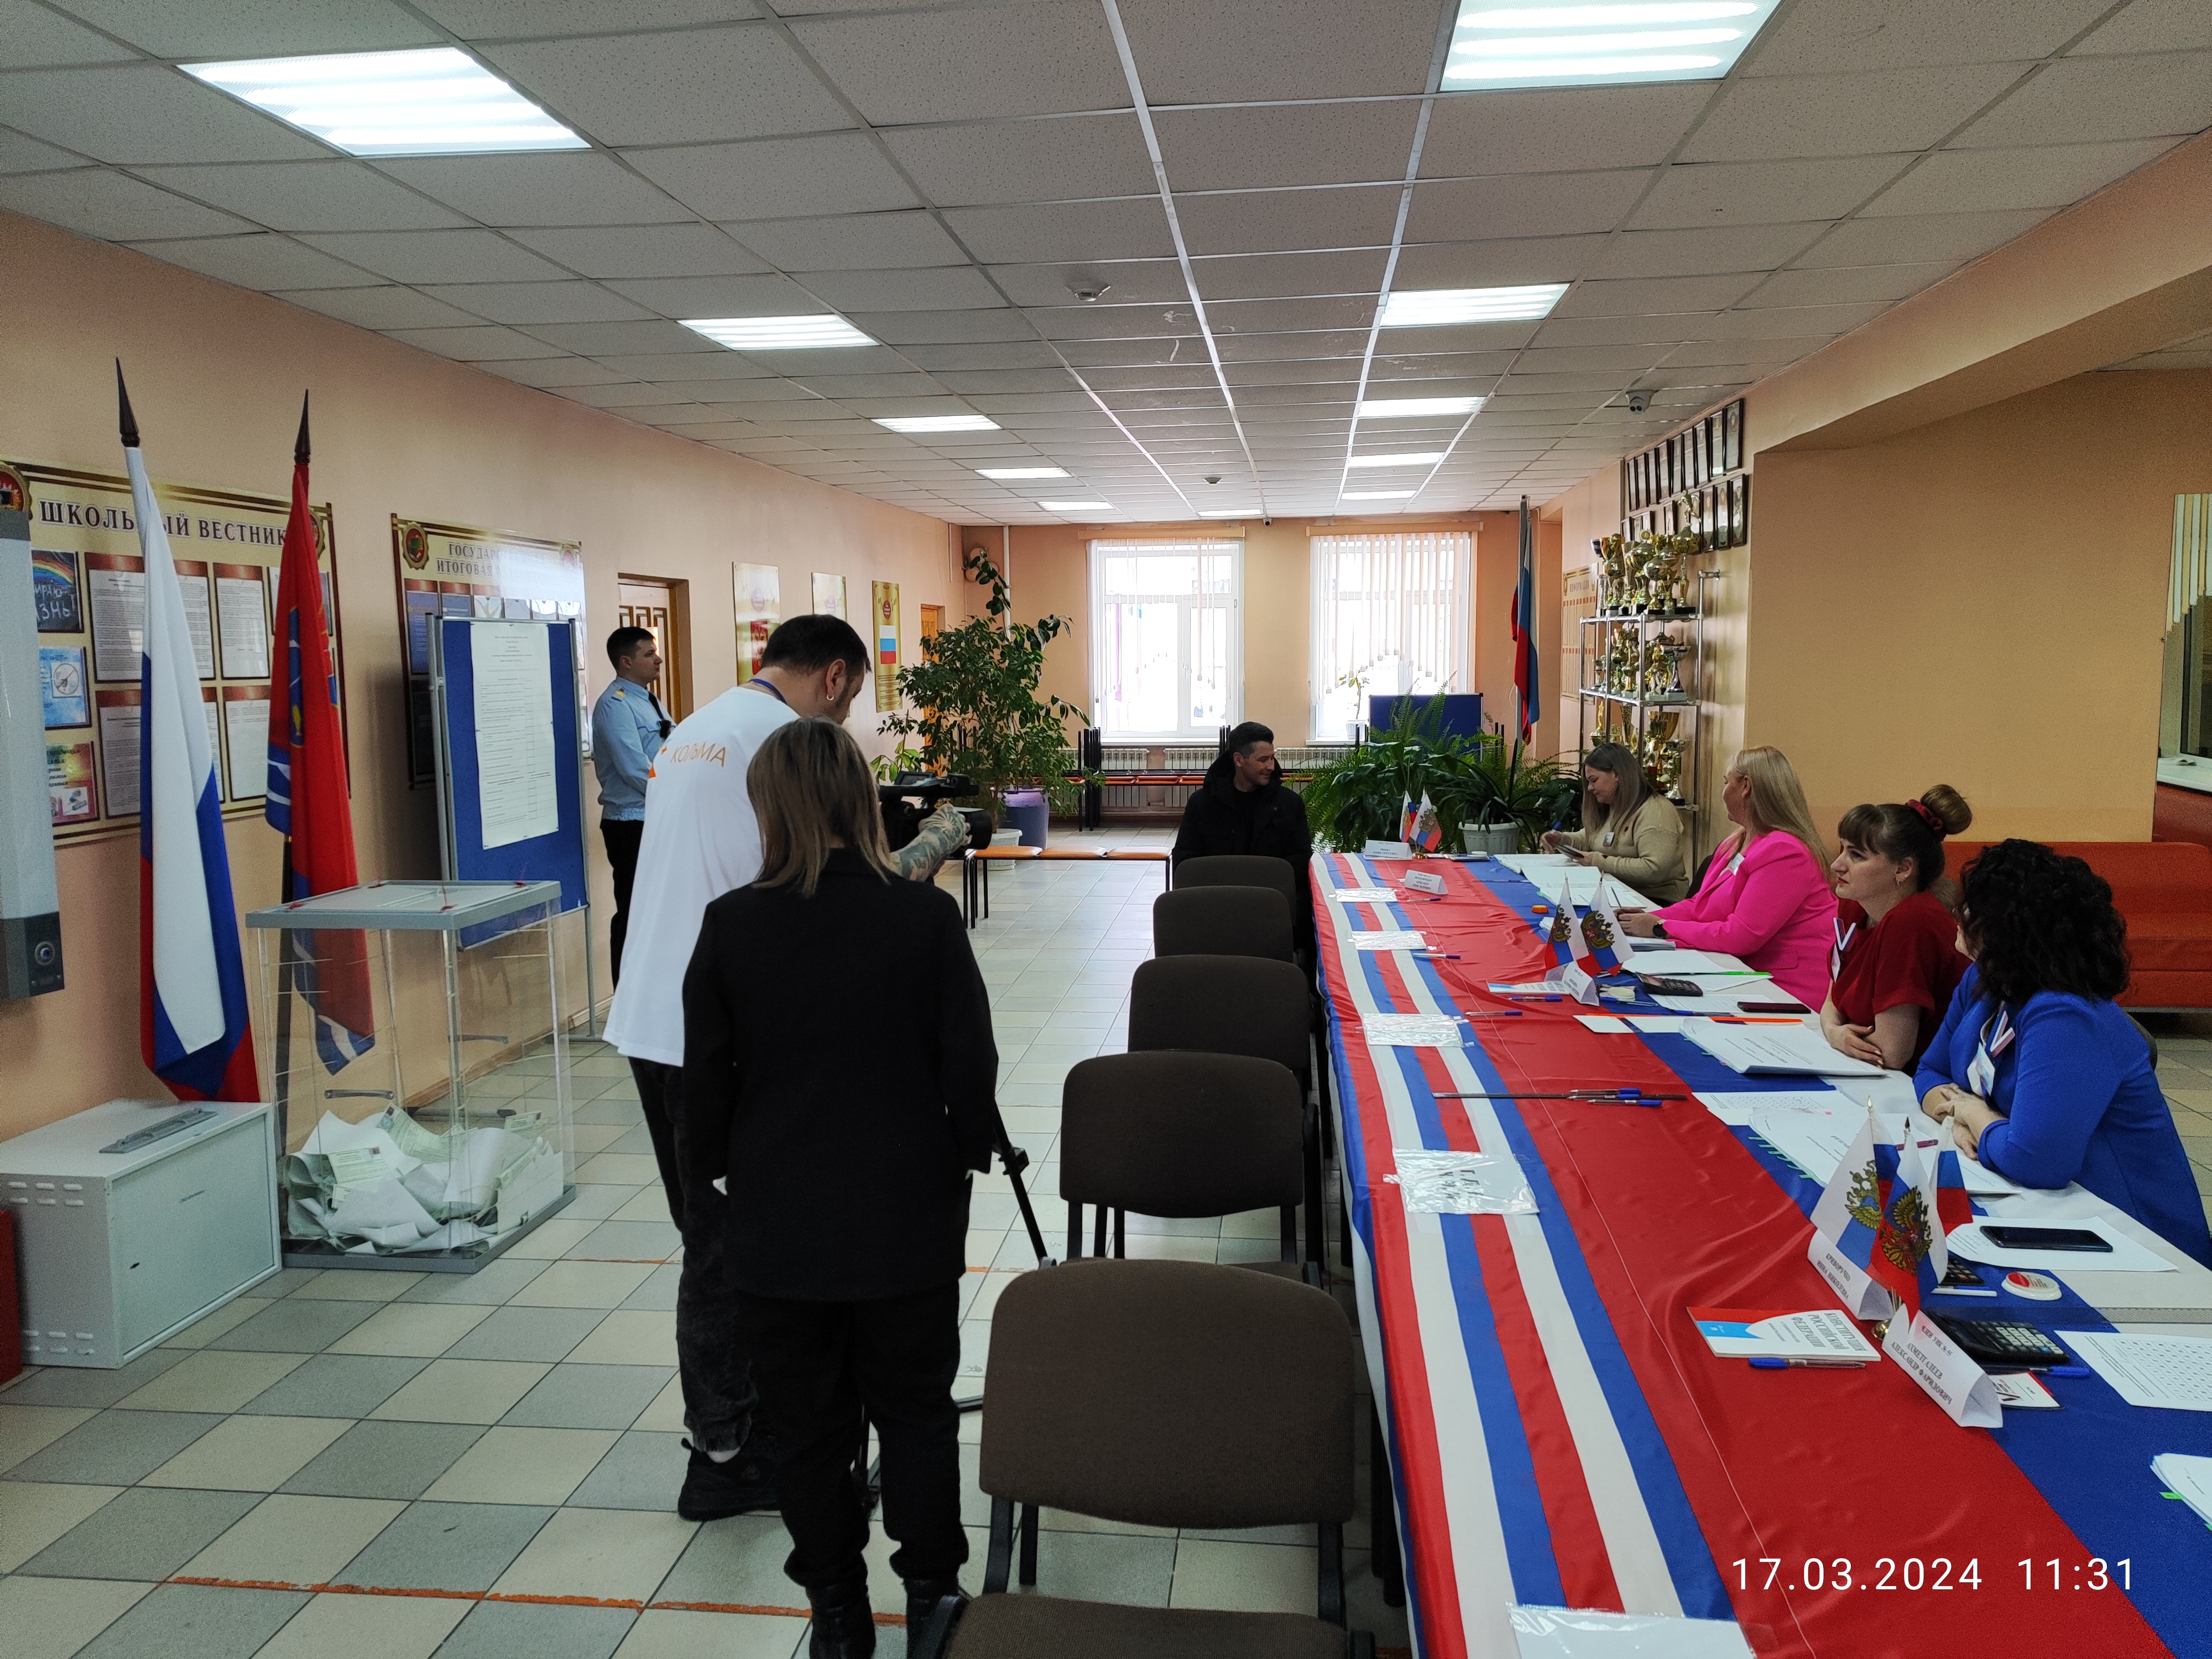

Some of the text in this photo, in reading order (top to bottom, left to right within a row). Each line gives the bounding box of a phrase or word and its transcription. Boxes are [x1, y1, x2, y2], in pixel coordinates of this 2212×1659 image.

[39, 500, 286, 545] ШКОЛЬЫЙ ВЕСТНИК
[437, 560, 493, 577] ИТОГОВАЯ
[1791, 1316, 1827, 1348] ФЕДЕРАЦИИ
[1807, 1313, 1850, 1350] РОССИЙСКОЙ
[1823, 1312, 1867, 1352] КОНСТИТУЦИЯ
[1891, 1342, 1953, 1405] АЛЕКСАНДР ФАРИДОВИЧ
